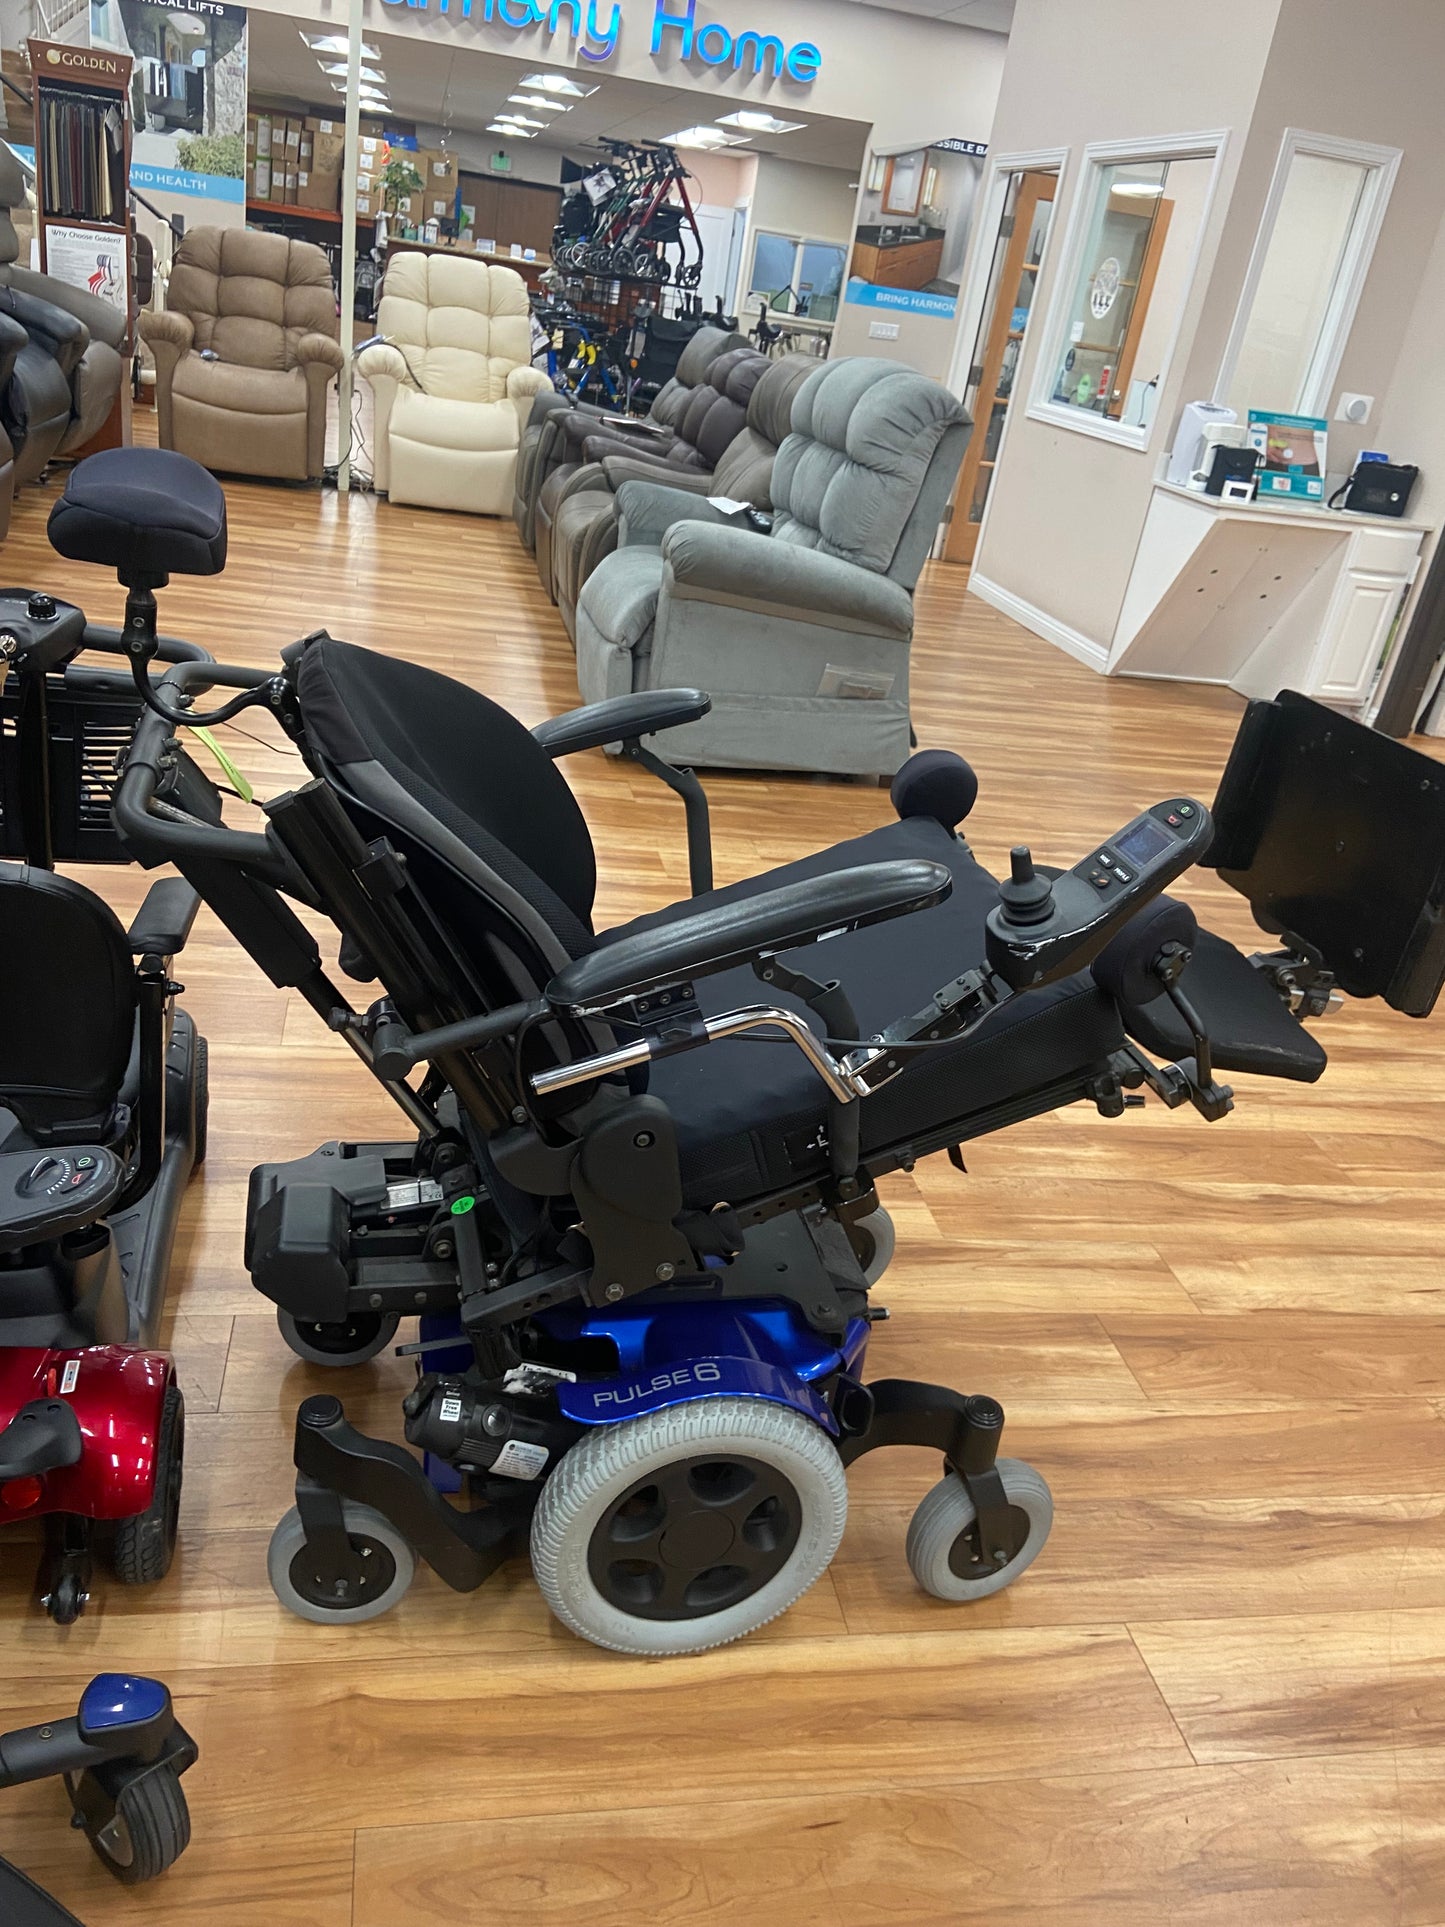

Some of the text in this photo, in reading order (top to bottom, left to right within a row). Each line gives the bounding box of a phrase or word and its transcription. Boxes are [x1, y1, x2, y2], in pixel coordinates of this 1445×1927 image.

[187, 3, 224, 16] LIFTS
[650, 0, 822, 82] Home
[61, 52, 117, 75] GOLDEN
[156, 174, 207, 190] HEALTH
[875, 292, 909, 306] BRING
